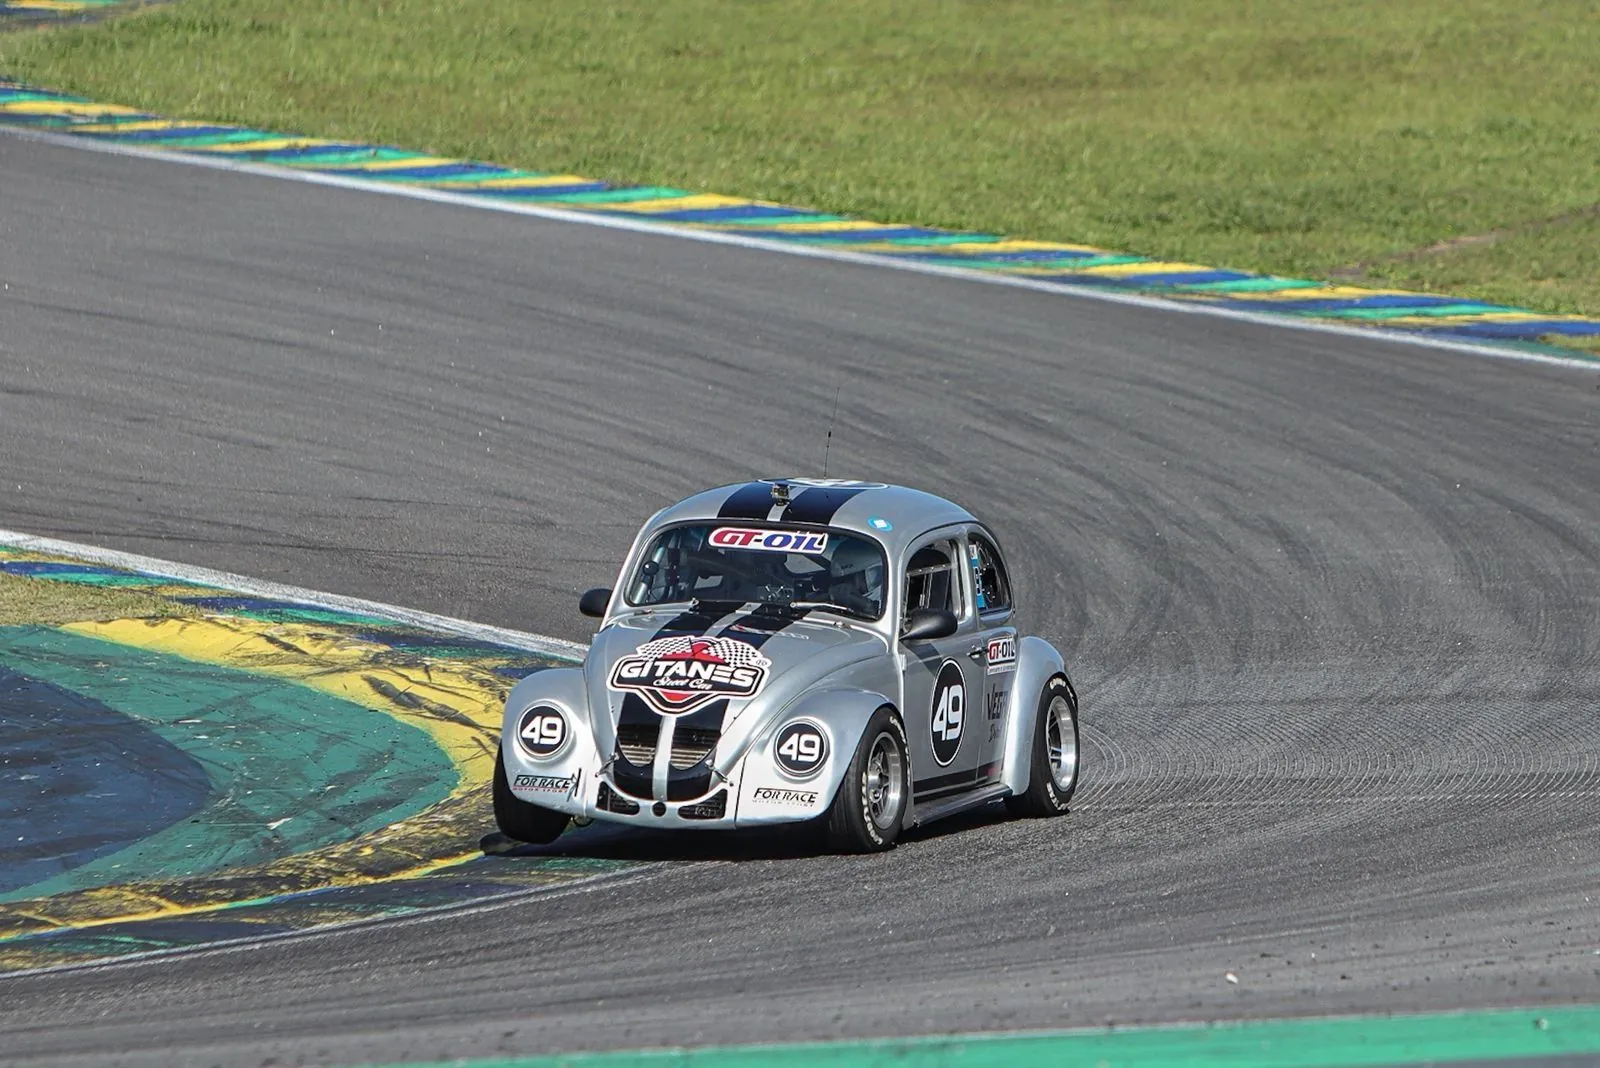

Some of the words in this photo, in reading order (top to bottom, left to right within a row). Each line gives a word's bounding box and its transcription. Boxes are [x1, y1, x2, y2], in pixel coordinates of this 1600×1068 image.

[713, 529, 824, 551] GT-OIL
[620, 660, 757, 687] GITANES
[933, 684, 963, 741] 49
[521, 715, 563, 745] 49
[779, 733, 821, 763] 49
[514, 775, 538, 787] FOR
[538, 777, 571, 789] RACE
[753, 788, 780, 799] FOR
[782, 790, 818, 804] RACE
